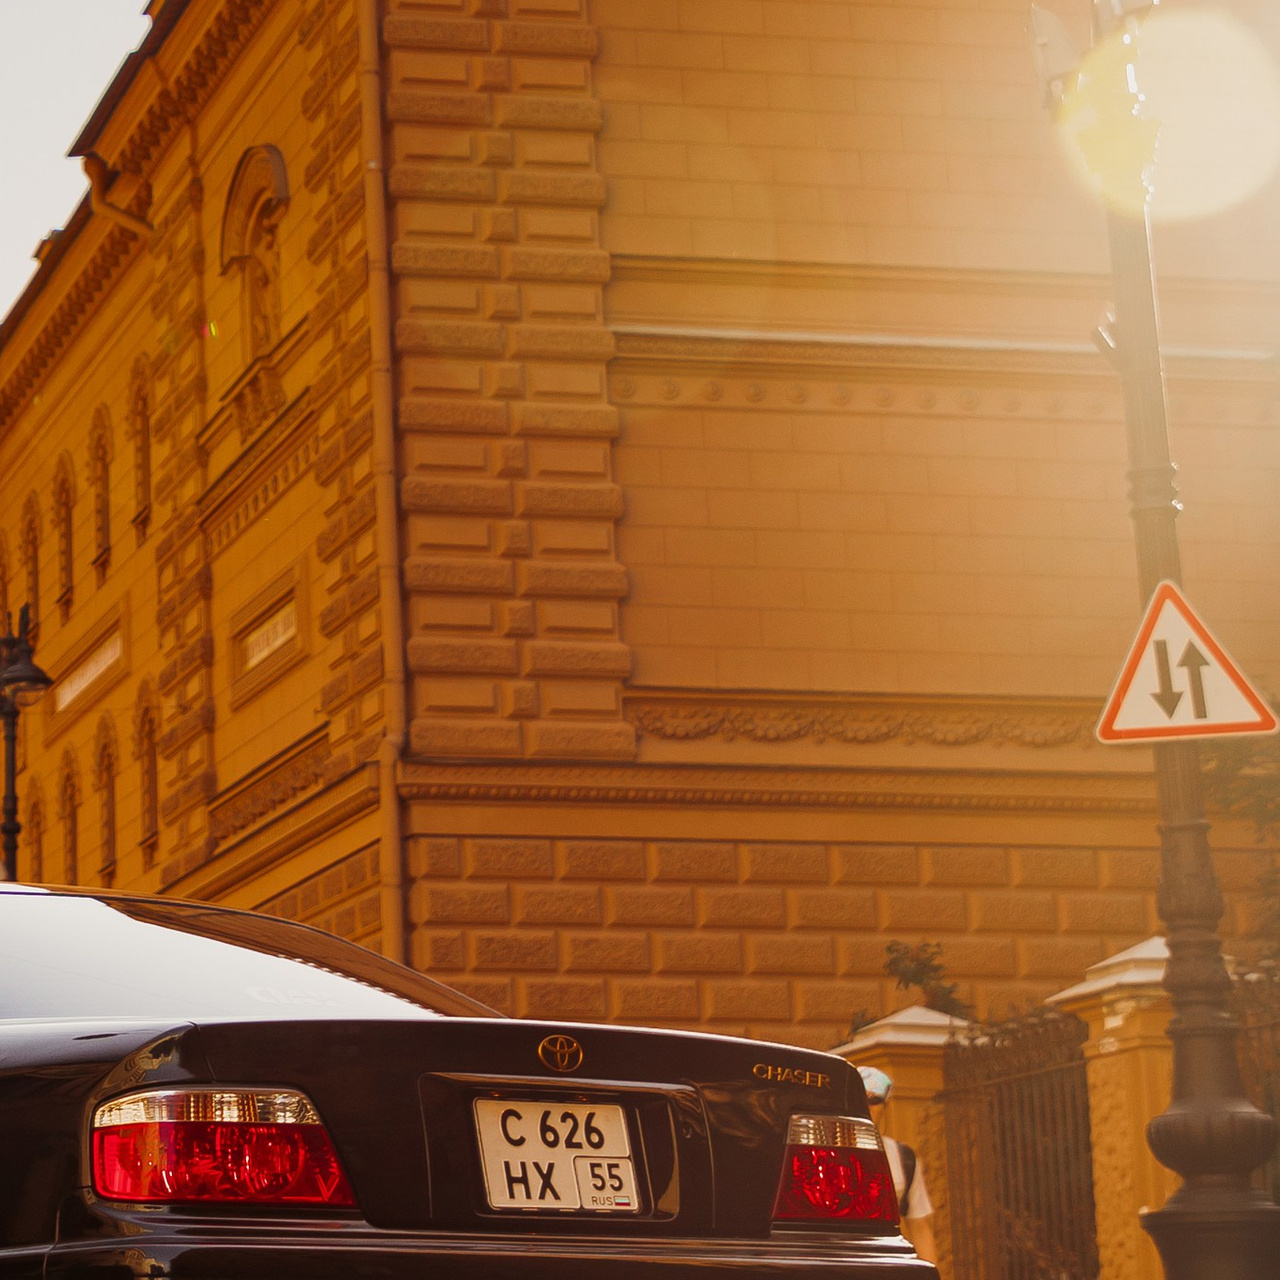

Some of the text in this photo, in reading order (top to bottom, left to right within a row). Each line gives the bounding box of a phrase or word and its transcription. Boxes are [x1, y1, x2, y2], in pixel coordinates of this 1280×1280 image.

[753, 1063, 832, 1088] CHASER
[539, 1110, 605, 1149] 626
[589, 1162, 623, 1191] 55
[591, 1196, 614, 1206] RUS
